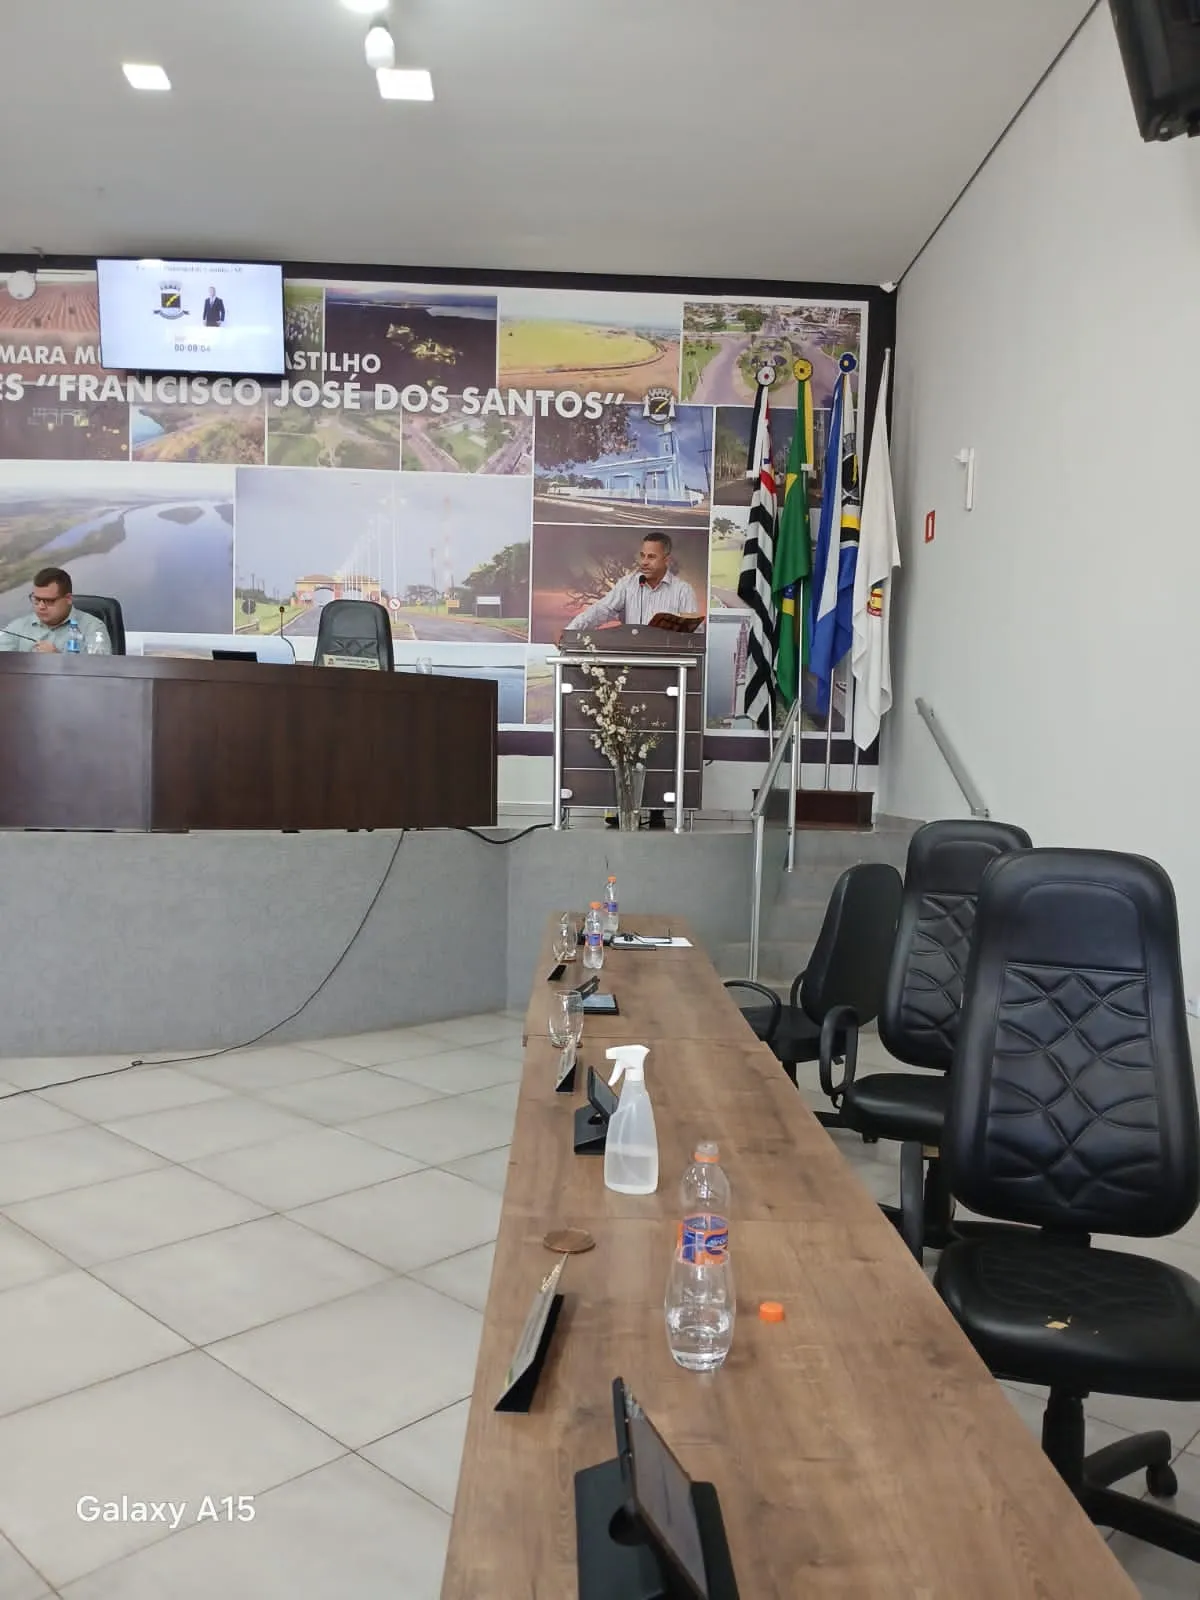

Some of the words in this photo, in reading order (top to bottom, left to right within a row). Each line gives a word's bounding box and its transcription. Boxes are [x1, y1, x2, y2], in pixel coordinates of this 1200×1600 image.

[74, 345, 101, 365] M
[36, 373, 262, 406] “FRANCISCO
[273, 373, 361, 410] JOSÉ
[374, 383, 449, 413] DOS
[461, 386, 625, 419] SANTOS”
